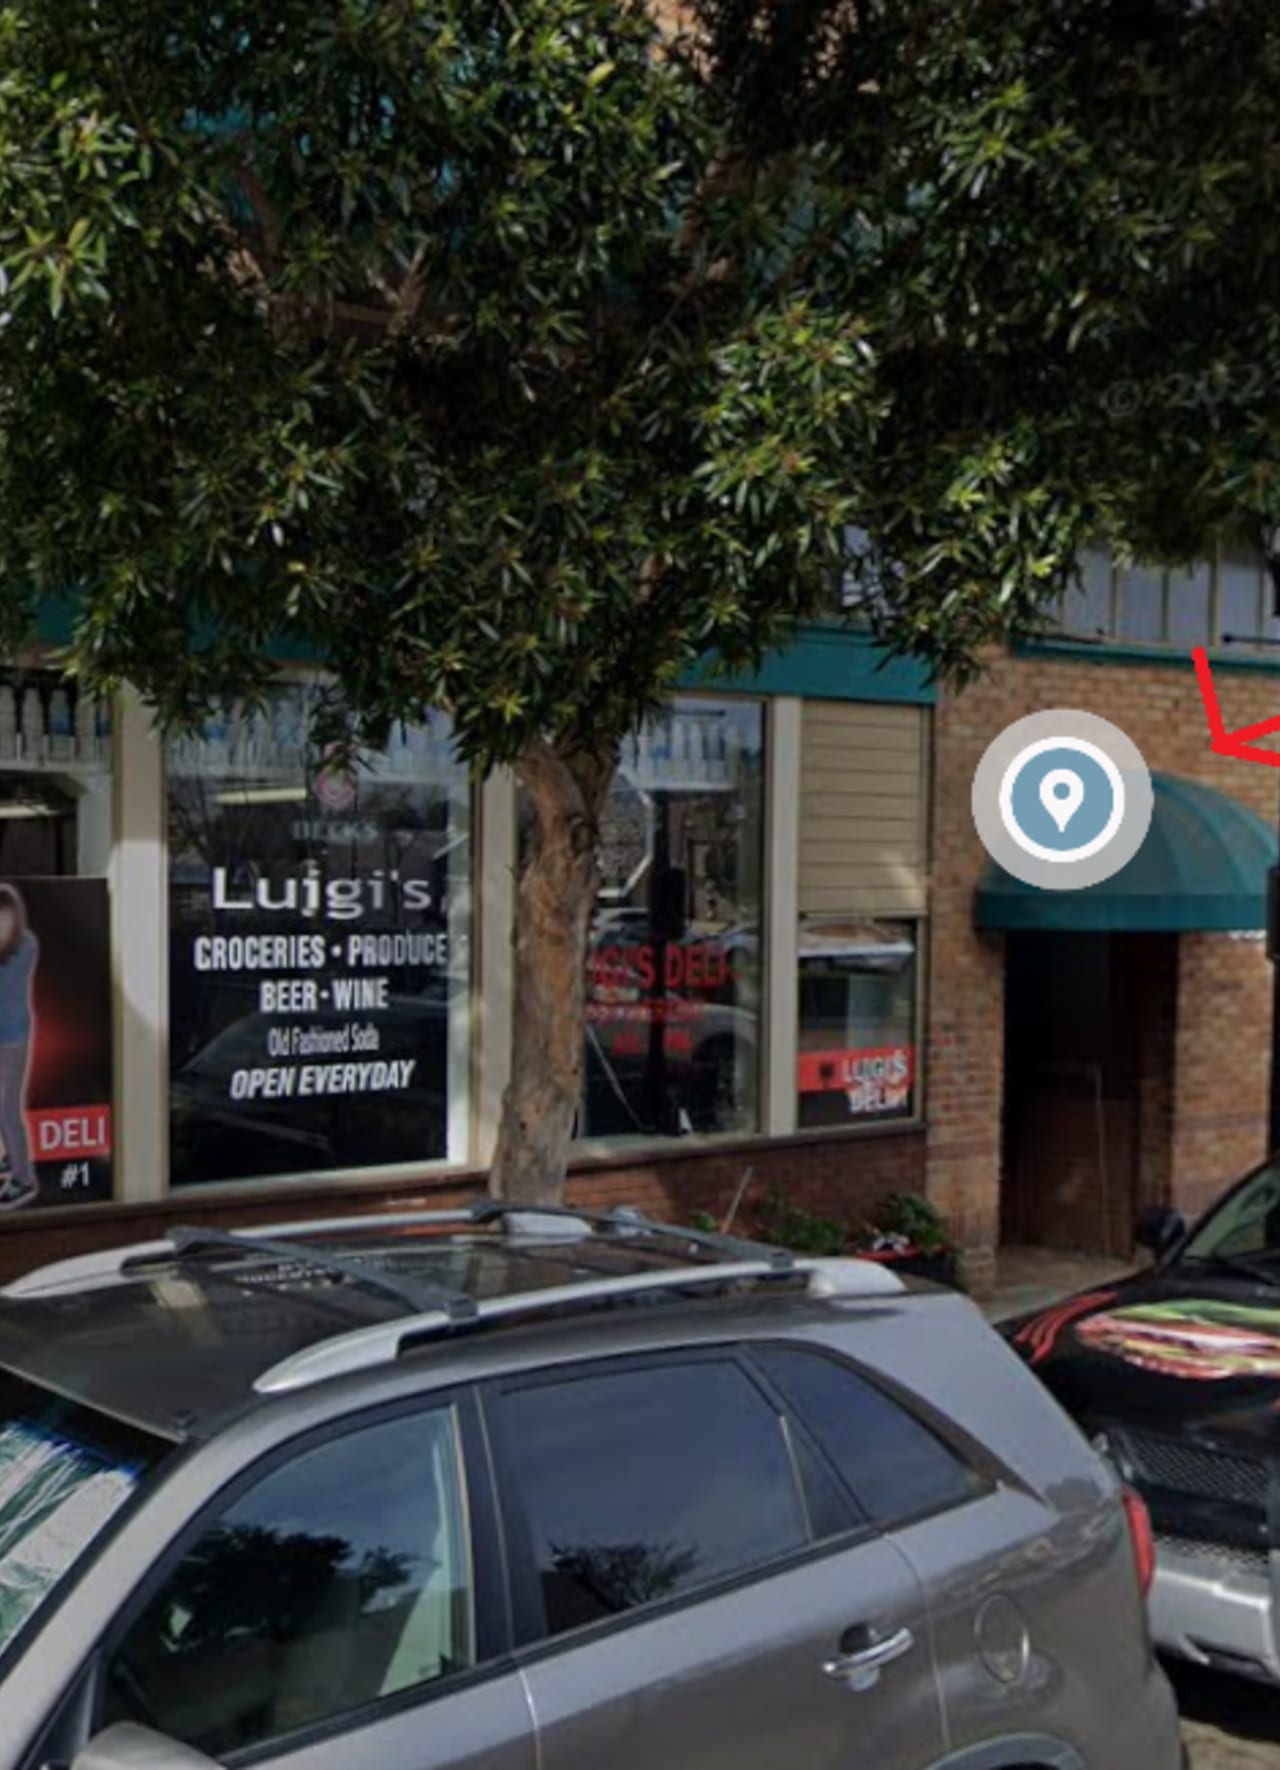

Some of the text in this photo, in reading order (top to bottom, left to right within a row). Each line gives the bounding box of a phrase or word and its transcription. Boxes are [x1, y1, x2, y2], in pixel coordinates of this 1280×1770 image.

[212, 866, 432, 920] Luigi's
[194, 933, 448, 970] GROCERIES PRODUCE
[260, 977, 389, 1012] BEER WINE
[267, 1021, 380, 1057] Old Fashioned Soda
[230, 1059, 417, 1100] OPEN EVERYDAY
[40, 1116, 106, 1151] DELI
[60, 1162, 90, 1189] #1
